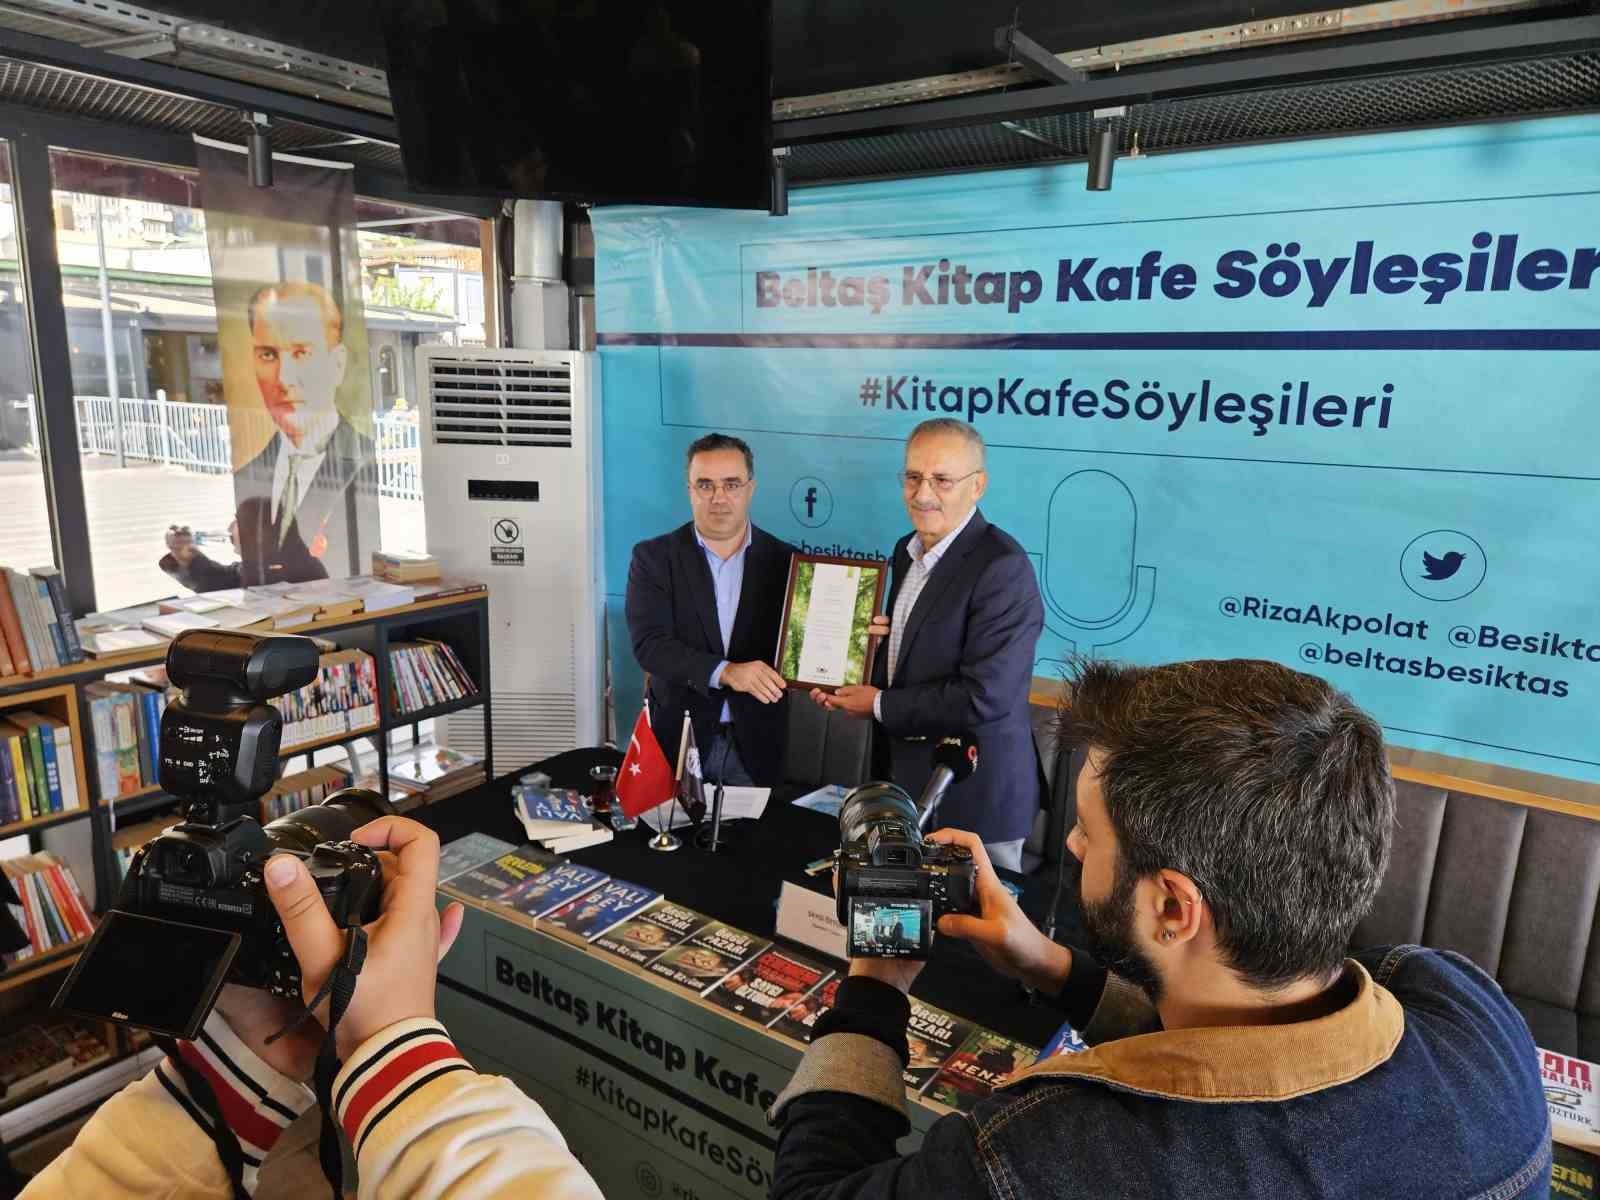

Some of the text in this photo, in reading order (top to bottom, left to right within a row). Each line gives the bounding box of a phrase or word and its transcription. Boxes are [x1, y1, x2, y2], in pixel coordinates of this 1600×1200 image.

[755, 266, 891, 314] Beltaş
[901, 258, 1043, 314] Kitap
[1055, 250, 1197, 302] Kafe
[859, 375, 1395, 437] #KitapKafeSöyleşileri
[1218, 596, 1430, 641] @RizaAkpolat
[1299, 643, 1570, 698] @beltasbesiktas
[494, 956, 590, 1026] Beltaş
[597, 1000, 687, 1072] Kitap
[908, 1016, 952, 1041] AZARI
[951, 1060, 1008, 1087] MENZ
